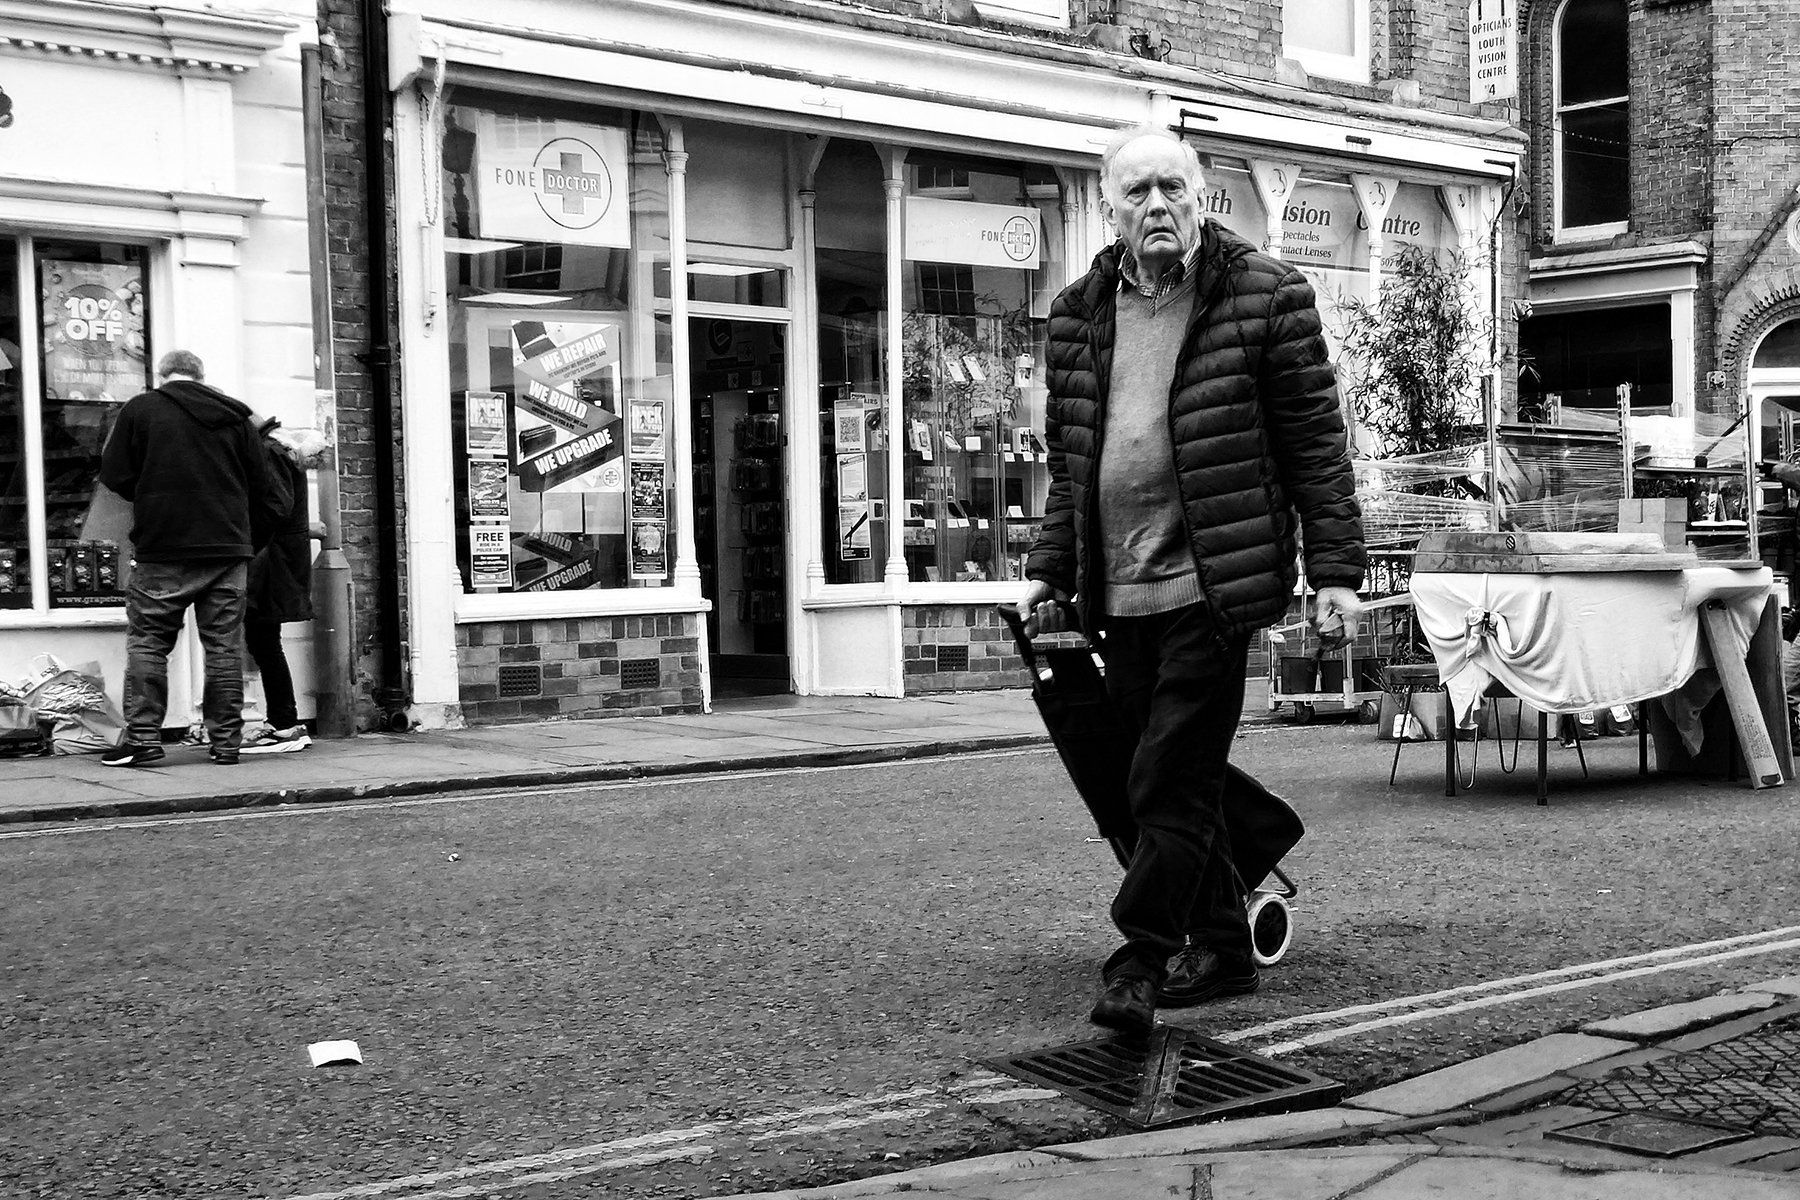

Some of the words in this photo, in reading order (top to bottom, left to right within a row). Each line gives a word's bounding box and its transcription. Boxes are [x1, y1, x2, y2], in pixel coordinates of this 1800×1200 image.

[1472, 18, 1512, 34] OPTICIANS
[1478, 36, 1505, 50] LOUTH
[1478, 51, 1506, 64] VISION
[1478, 65, 1507, 79] CENTRE
[1488, 84, 1496, 96] 4
[496, 168, 536, 188] FONE
[547, 174, 598, 193] DOCTOR
[1282, 199, 1332, 226] ision
[1356, 210, 1420, 236] Cntre
[981, 230, 1004, 243] FONE
[1282, 230, 1320, 242] pectacles
[1262, 240, 1270, 252] &
[1304, 246, 1332, 258] Lenses
[64, 296, 122, 320] 10%
[66, 320, 123, 342] OFF
[540, 350, 563, 372] WE
[560, 333, 606, 364] REPAIR
[528, 380, 550, 402] WE
[548, 390, 588, 420] BUILD
[534, 453, 558, 476] WE
[554, 428, 614, 466] UPGRADE
[476, 532, 504, 542] FREE
[541, 532, 572, 552] BUILD
[546, 559, 592, 590] UPGRADE
